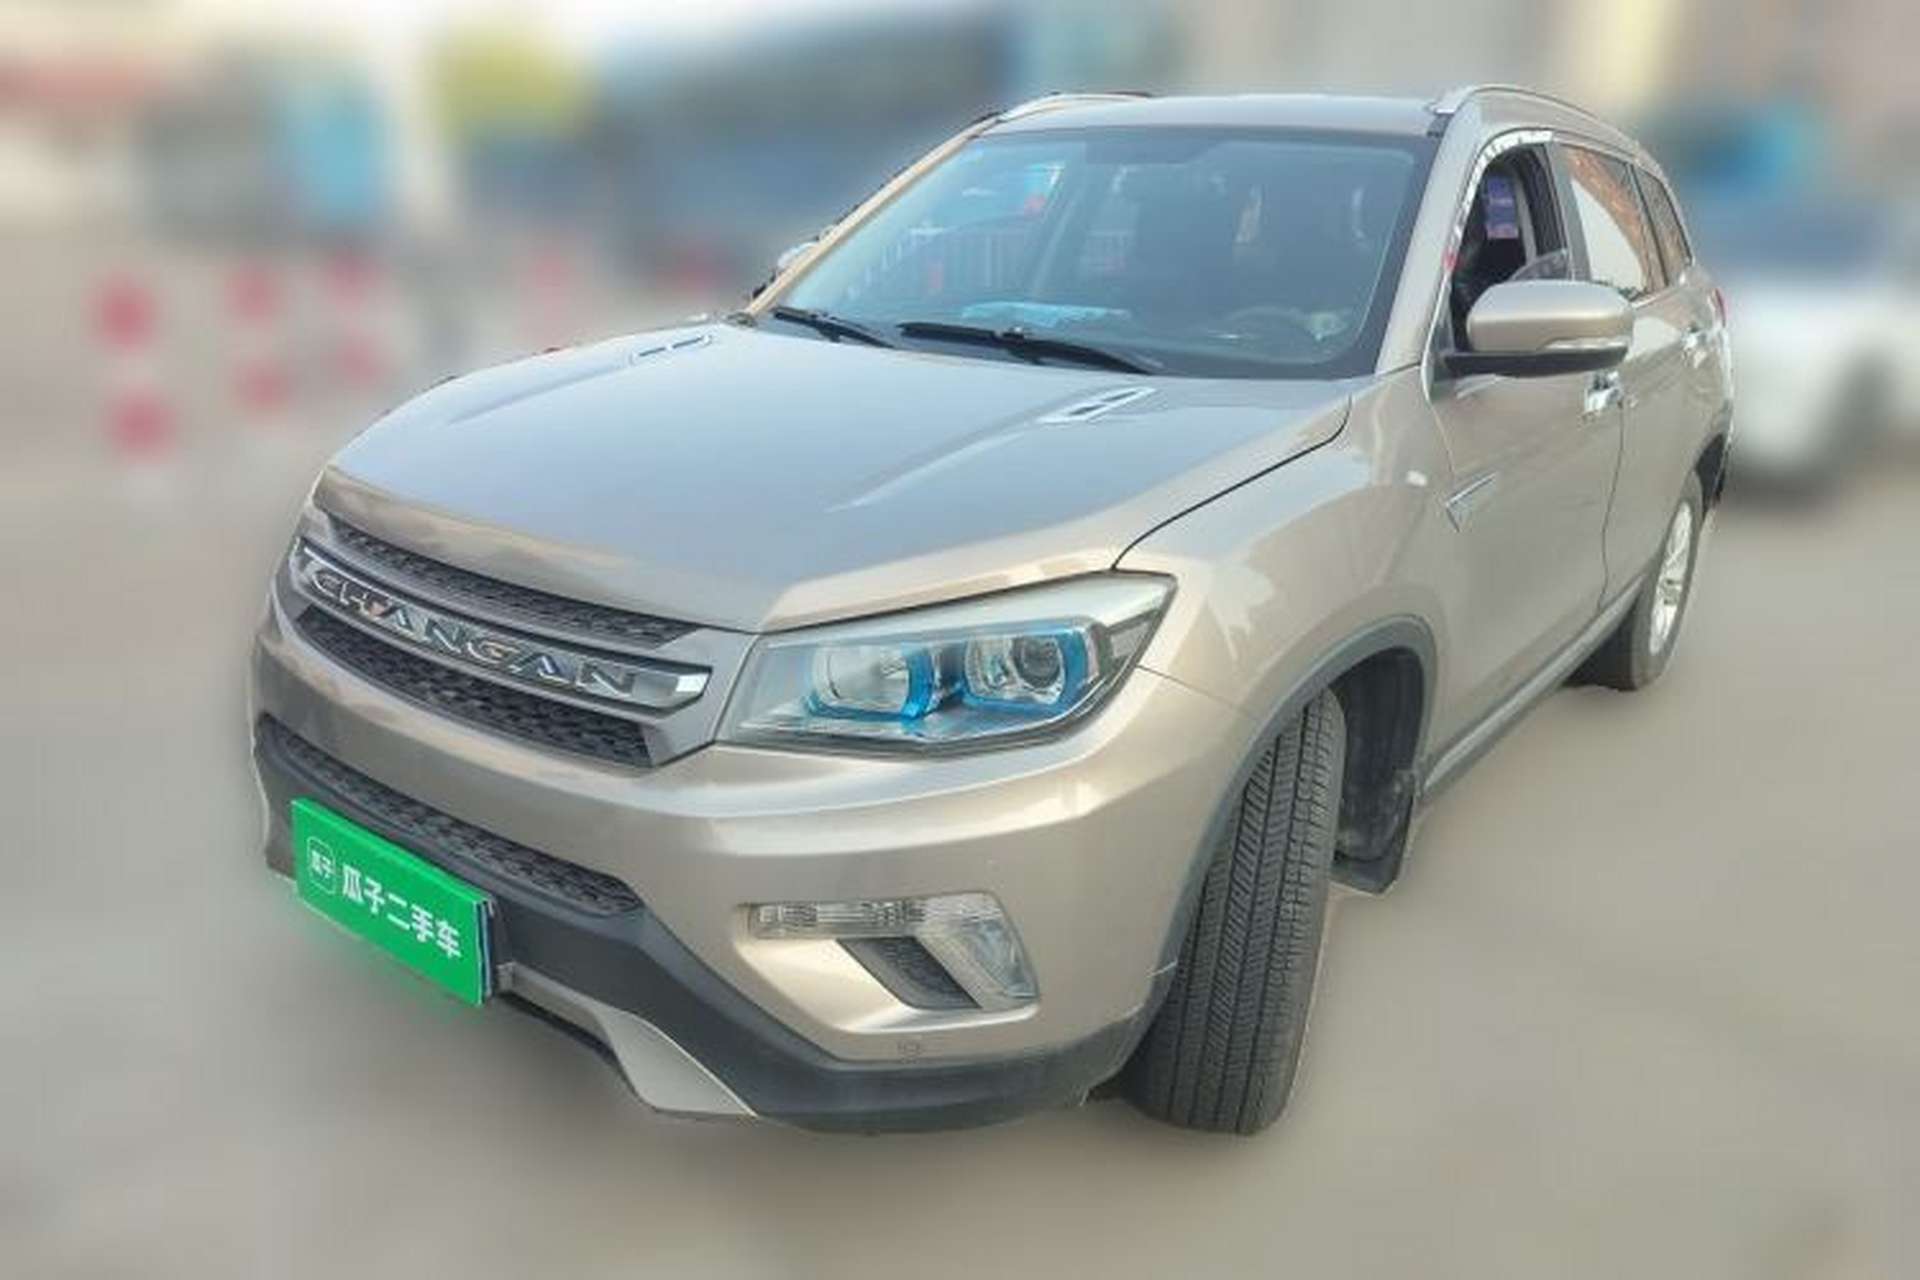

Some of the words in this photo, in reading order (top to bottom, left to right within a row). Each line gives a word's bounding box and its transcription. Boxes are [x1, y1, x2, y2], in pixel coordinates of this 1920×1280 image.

[303, 560, 636, 698] CHANGAN
[342, 863, 462, 960] 瓜子二手车
